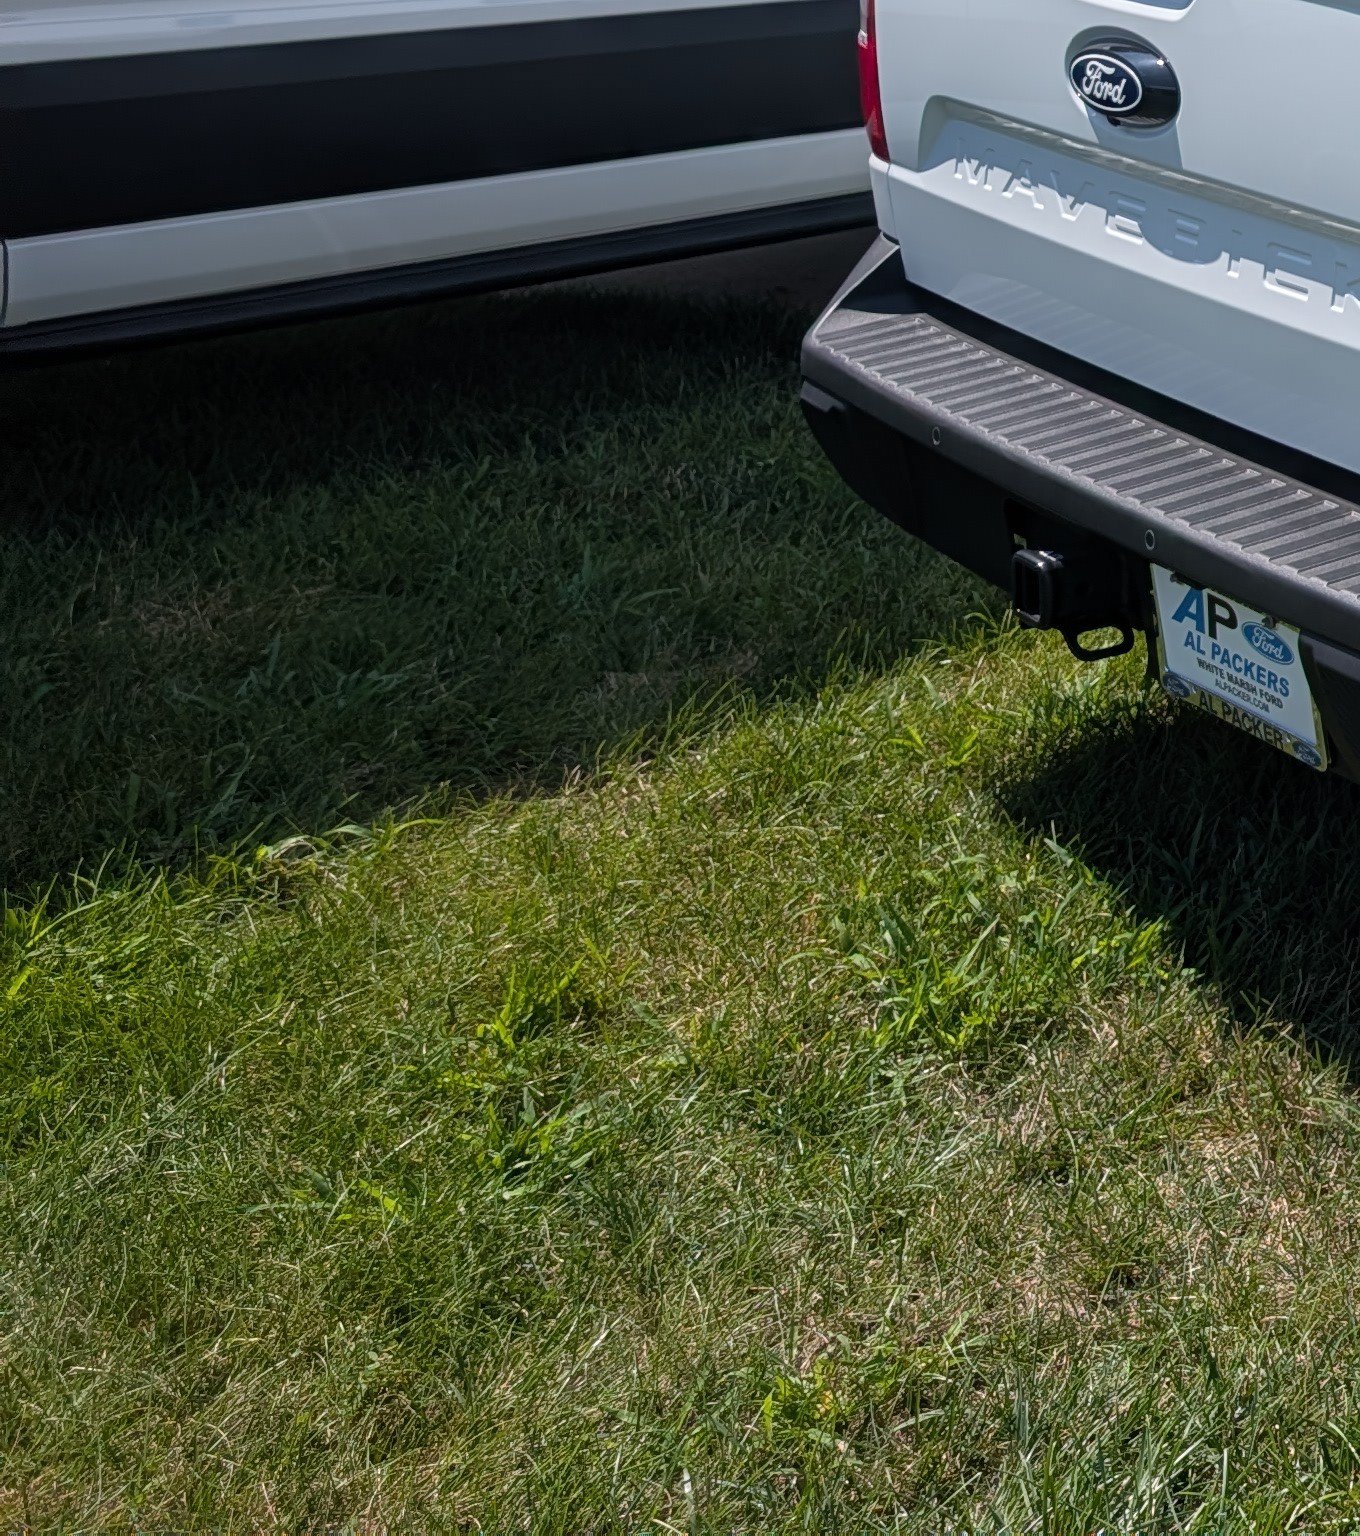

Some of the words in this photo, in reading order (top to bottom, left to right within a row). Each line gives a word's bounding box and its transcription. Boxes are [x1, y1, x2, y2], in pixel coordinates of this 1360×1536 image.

[1082, 60, 1127, 105] Ford
[1172, 586, 1239, 641] AP
[1252, 626, 1285, 662] Ford
[1184, 630, 1206, 656] AL
[1211, 643, 1290, 698] PACKERS
[1196, 656, 1225, 681] WHITE
[1227, 670, 1258, 697] MARSH
[1259, 686, 1284, 710] FORD
